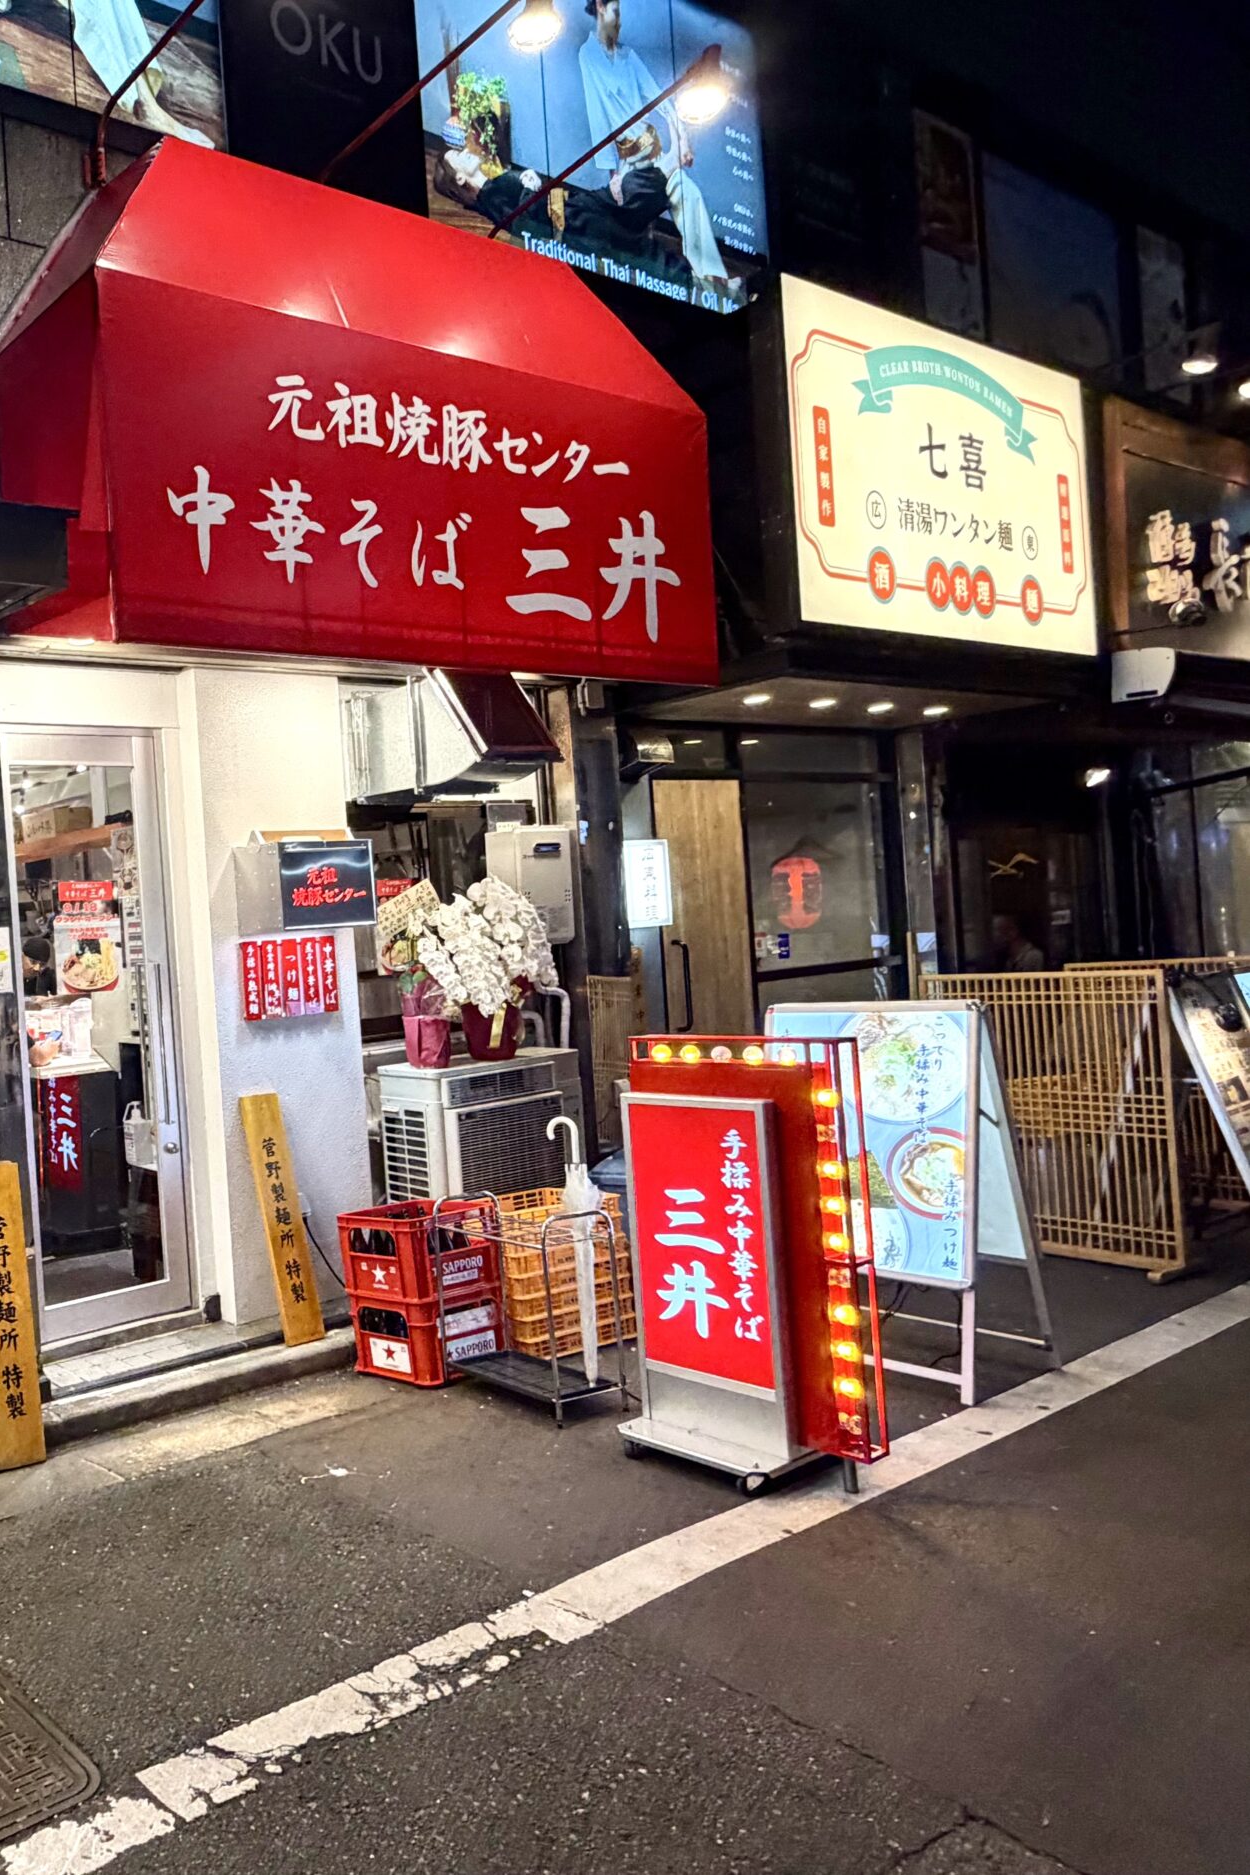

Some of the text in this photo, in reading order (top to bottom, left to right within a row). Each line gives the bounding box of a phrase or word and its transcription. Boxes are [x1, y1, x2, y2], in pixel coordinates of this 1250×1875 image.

[270, 0, 383, 84] OKU
[521, 231, 597, 273] Traditional
[601, 258, 630, 283] Thai
[635, 269, 687, 301] Massage
[701, 291, 718, 314] Oil
[879, 360, 1013, 418] CLEAR BROTH WONTON RAMEN
[268, 374, 630, 483] 元祖焼豚センター
[919, 422, 987, 491] 七喜
[874, 562, 890, 591] 酒
[932, 571, 991, 607] 小料理
[292, 887, 367, 906] 焼豚センター
[307, 866, 338, 885] 元祖
[323, 943, 337, 1005] 中華そば
[933, 1015, 946, 1071] こってり
[654, 1188, 730, 1339] 三井
[720, 1129, 765, 1342] 手揉み中華そば
[442, 1255, 483, 1275] SAPPORO
[455, 1338, 495, 1359] SAPPORO
[2, 1365, 27, 1419] 特製
